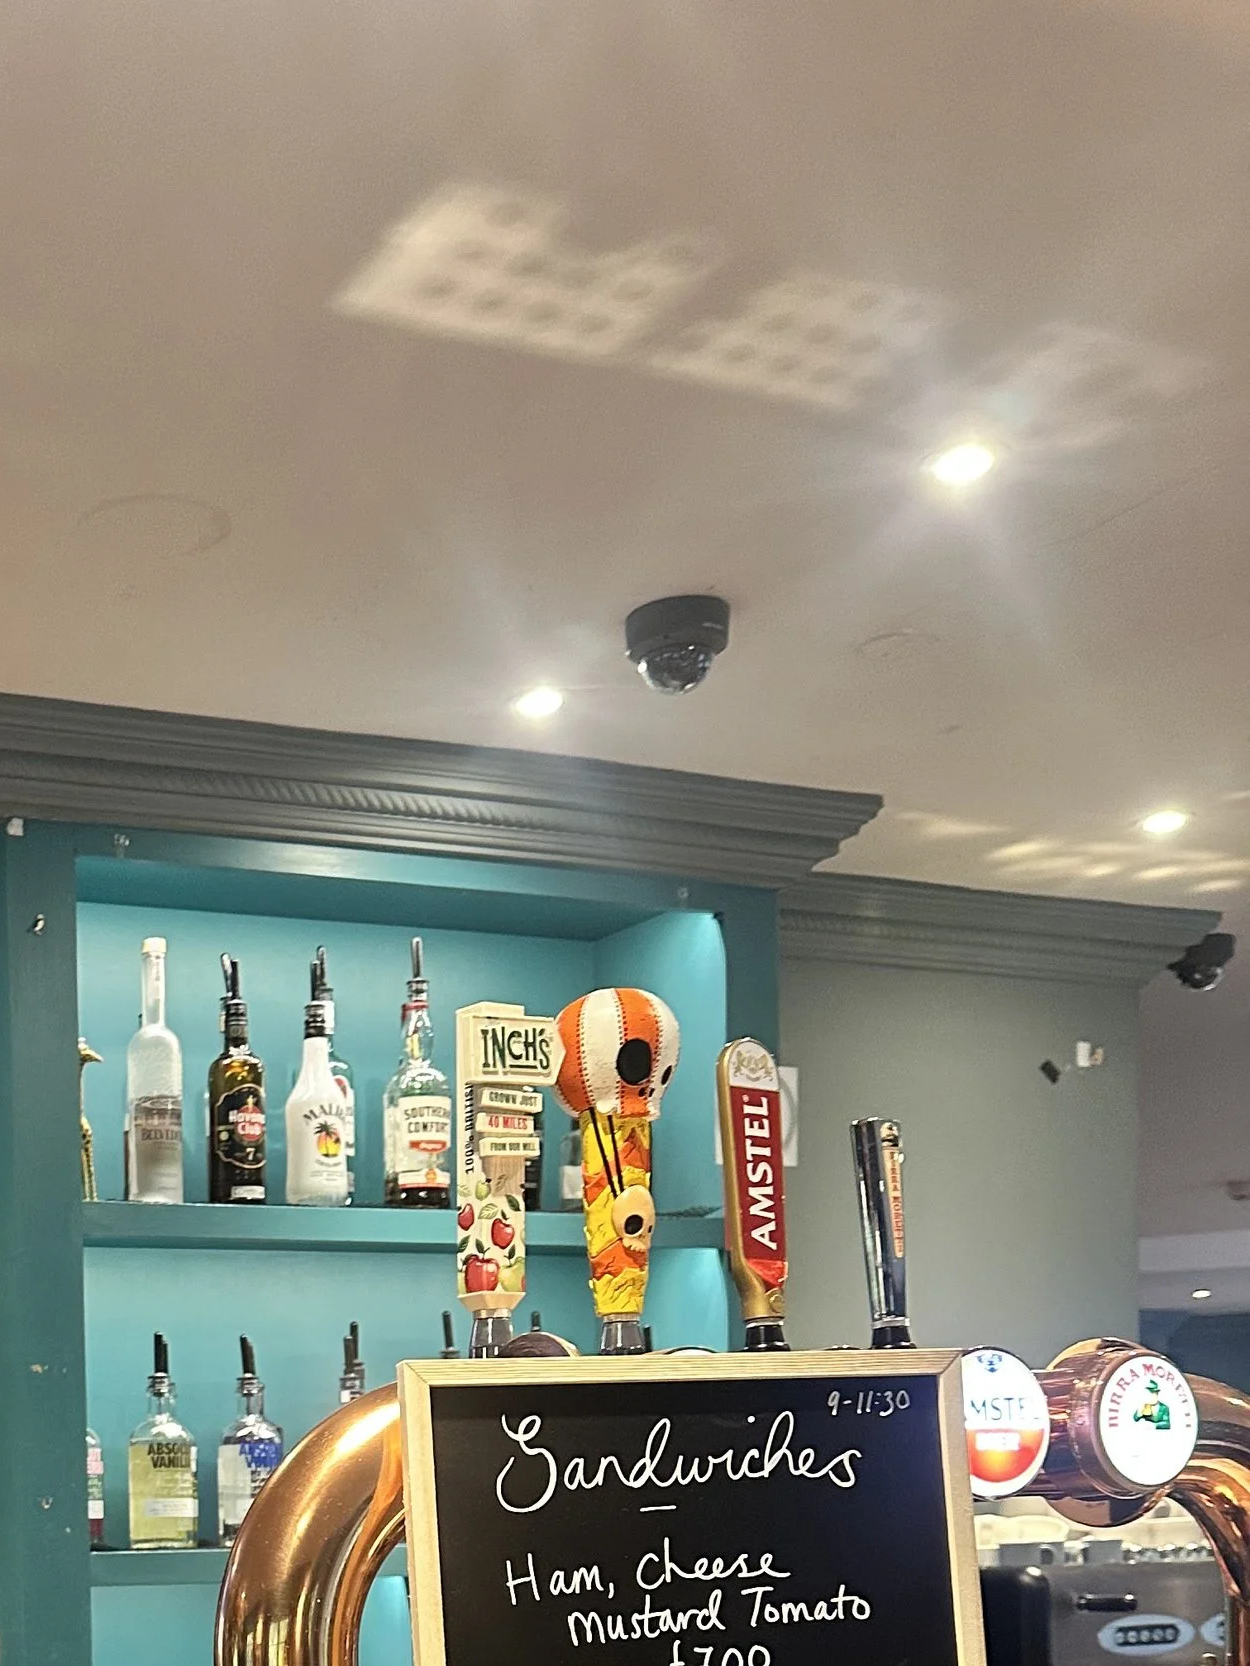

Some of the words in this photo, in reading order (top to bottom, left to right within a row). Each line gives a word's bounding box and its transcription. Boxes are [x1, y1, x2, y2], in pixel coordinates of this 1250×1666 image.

[481, 1026, 550, 1070] INCH'S
[488, 1091, 518, 1105] GROWN
[519, 1094, 539, 1107] JUST
[488, 1115, 500, 1128] 40
[502, 1117, 528, 1131] MILES
[743, 1096, 777, 1250] AMSTEL
[495, 1409, 863, 1512] Sandwiches
[505, 1552, 615, 1606] Ham,
[741, 1583, 872, 1628] Tomato
